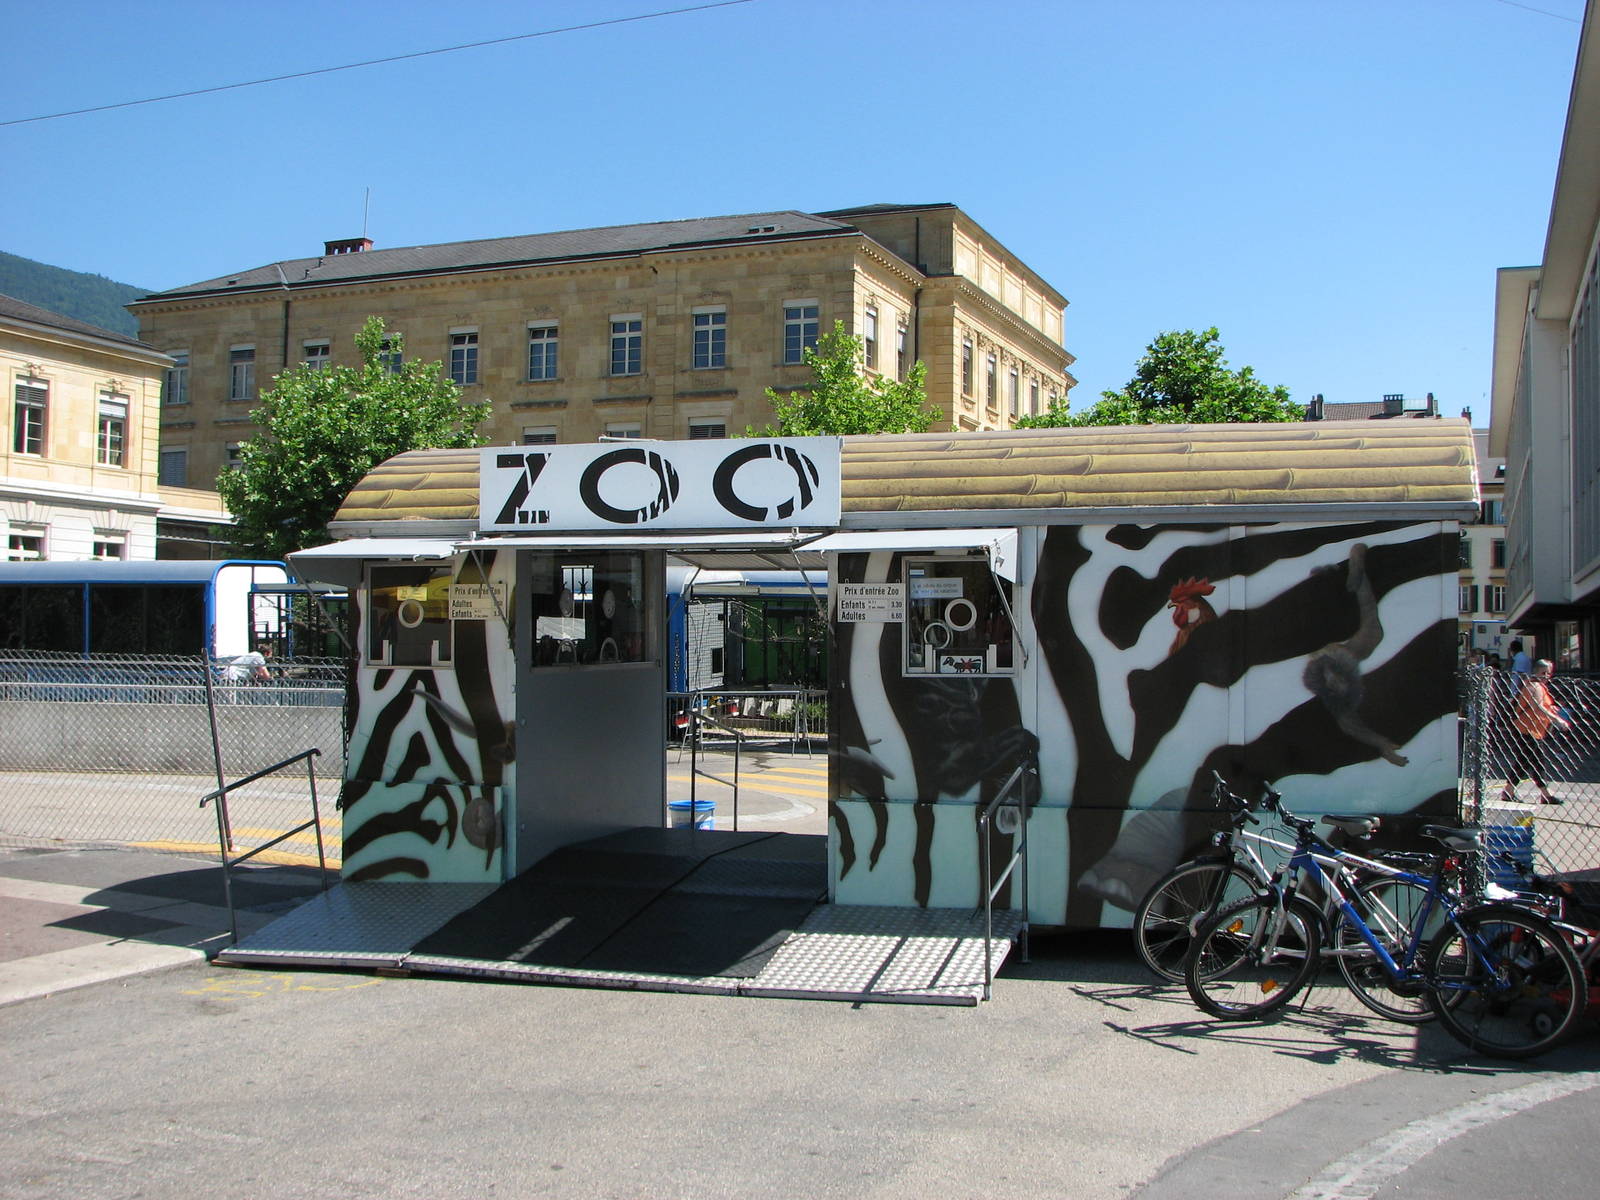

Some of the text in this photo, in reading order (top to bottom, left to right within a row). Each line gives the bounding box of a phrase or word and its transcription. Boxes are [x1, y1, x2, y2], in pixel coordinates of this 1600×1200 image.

[494, 443, 819, 524] ZOO
[455, 587, 466, 595] Prix
[844, 586, 900, 596] Prix d'entrée Zoo
[452, 600, 473, 608] Adultes
[841, 600, 866, 610] Enfants
[452, 609, 473, 618] Enfants
[841, 611, 866, 621] Adultes
